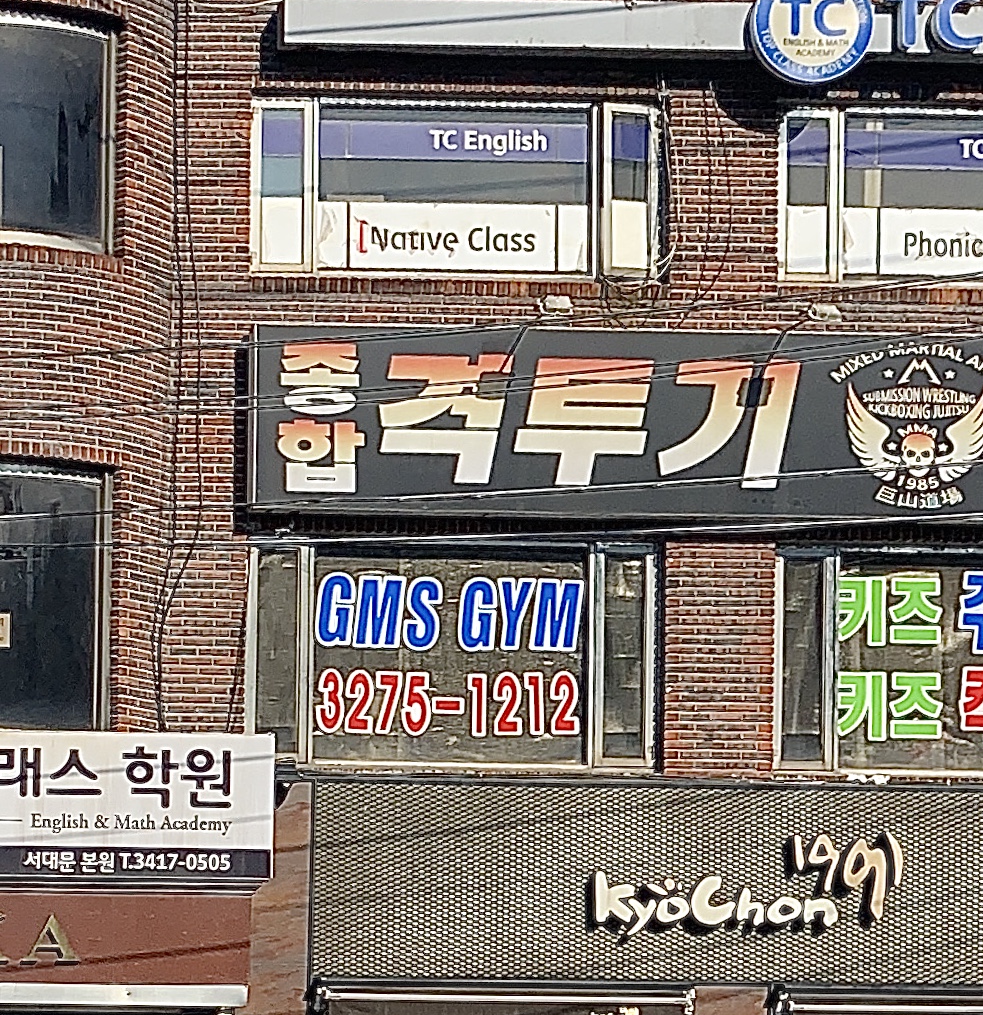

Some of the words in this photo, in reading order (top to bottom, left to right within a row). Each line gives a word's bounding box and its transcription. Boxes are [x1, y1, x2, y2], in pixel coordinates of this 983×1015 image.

[783, 38, 816, 46] ENGLISH
[429, 130, 457, 151] TC
[464, 129, 548, 155] English
[468, 226, 536, 252] Class
[904, 231, 983, 258] Phonic
[829, 351, 884, 383] MIXED
[887, 341, 964, 362] MARTIAL
[862, 387, 921, 402] SUBMISSION
[923, 387, 976, 403] WRESTLING
[277, 342, 365, 493] 종합
[379, 353, 800, 489] 격투기
[868, 404, 930, 419] KICKBOXING
[897, 423, 938, 438] MMA
[897, 475, 940, 490] 1985
[315, 572, 442, 650] GMS
[457, 576, 585, 651] GYM
[839, 575, 943, 647] 키즈
[316, 668, 581, 737] 3275-1212
[838, 670, 943, 741] 키즈
[122, 746, 232, 809] 학원
[31, 813, 89, 833] English
[94, 814, 109, 830] &
[114, 815, 156, 830] Math
[160, 815, 233, 836] Academy
[23, 851, 77, 873] 서대문
[80, 852, 115, 874] 본원
[119, 853, 232, 871] T.3417-0505
